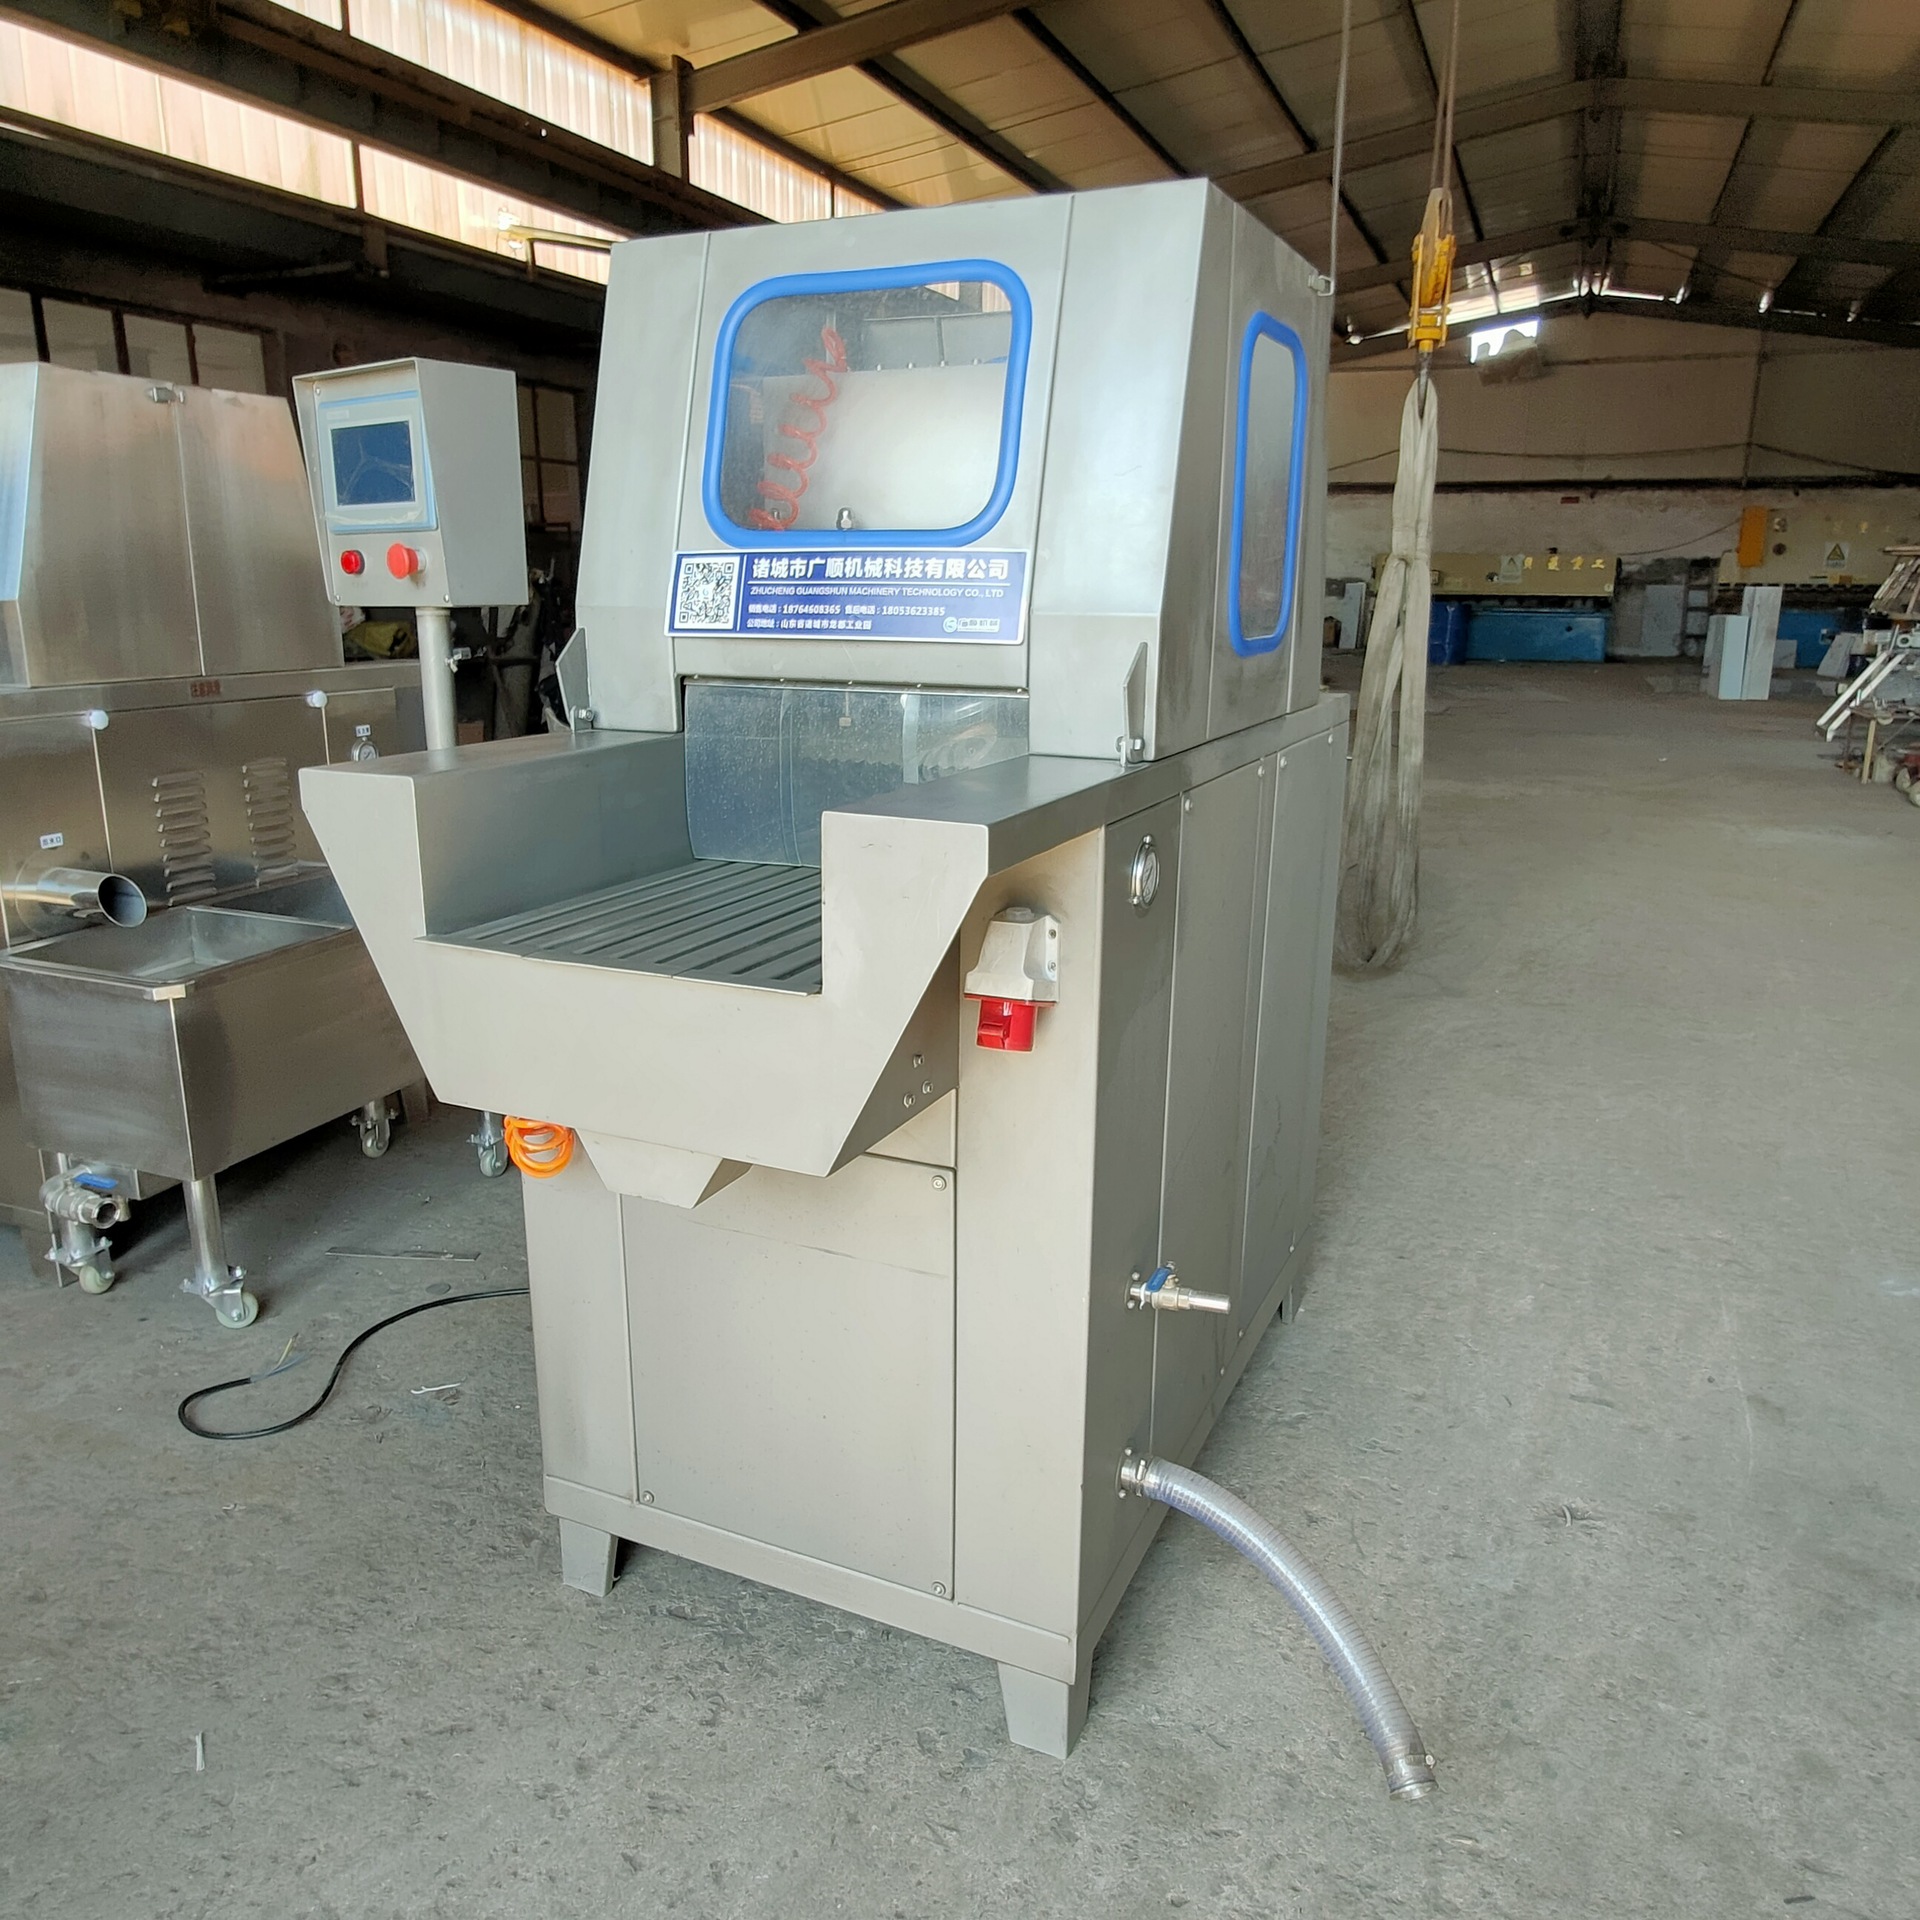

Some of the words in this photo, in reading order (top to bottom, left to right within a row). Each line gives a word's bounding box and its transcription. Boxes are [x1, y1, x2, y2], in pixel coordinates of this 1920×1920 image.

[752, 557, 1009, 580] 诸城市广顺机械科技有限公司
[750, 586, 795, 596] ZHUCHENG
[796, 586, 847, 596] GUANGSHUN
[849, 586, 901, 596] MACHINERY
[902, 587, 964, 597] TECHNOLOGY
[986, 588, 1004, 598] LTD
